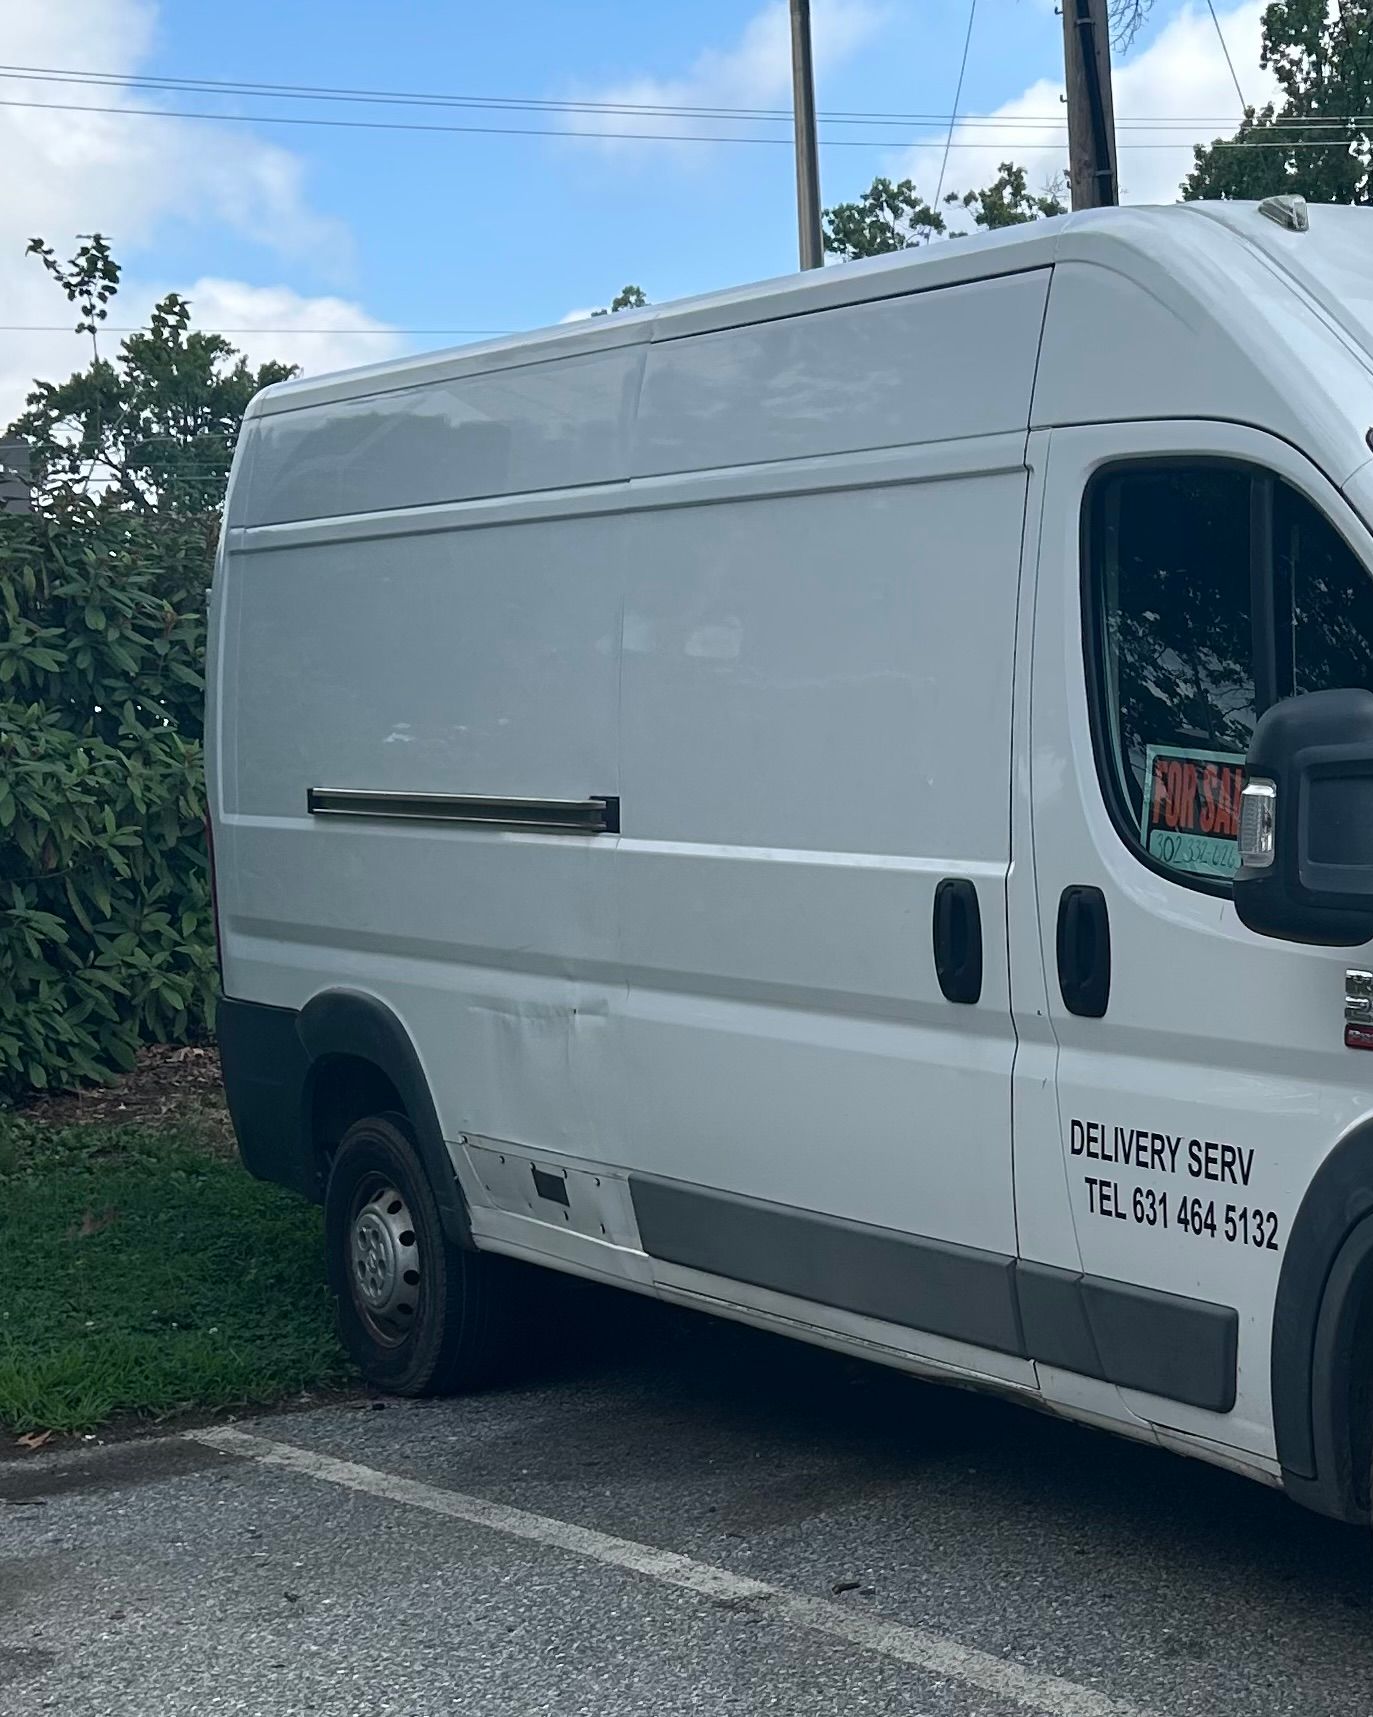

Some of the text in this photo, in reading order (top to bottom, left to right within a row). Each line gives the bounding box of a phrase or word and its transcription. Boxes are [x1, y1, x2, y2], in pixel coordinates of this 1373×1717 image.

[1152, 760, 1243, 836] FOR SAL
[1070, 1118, 1255, 1186] DELIVERY SERV
[1084, 1176, 1279, 1251] TEL 631 464 5132
